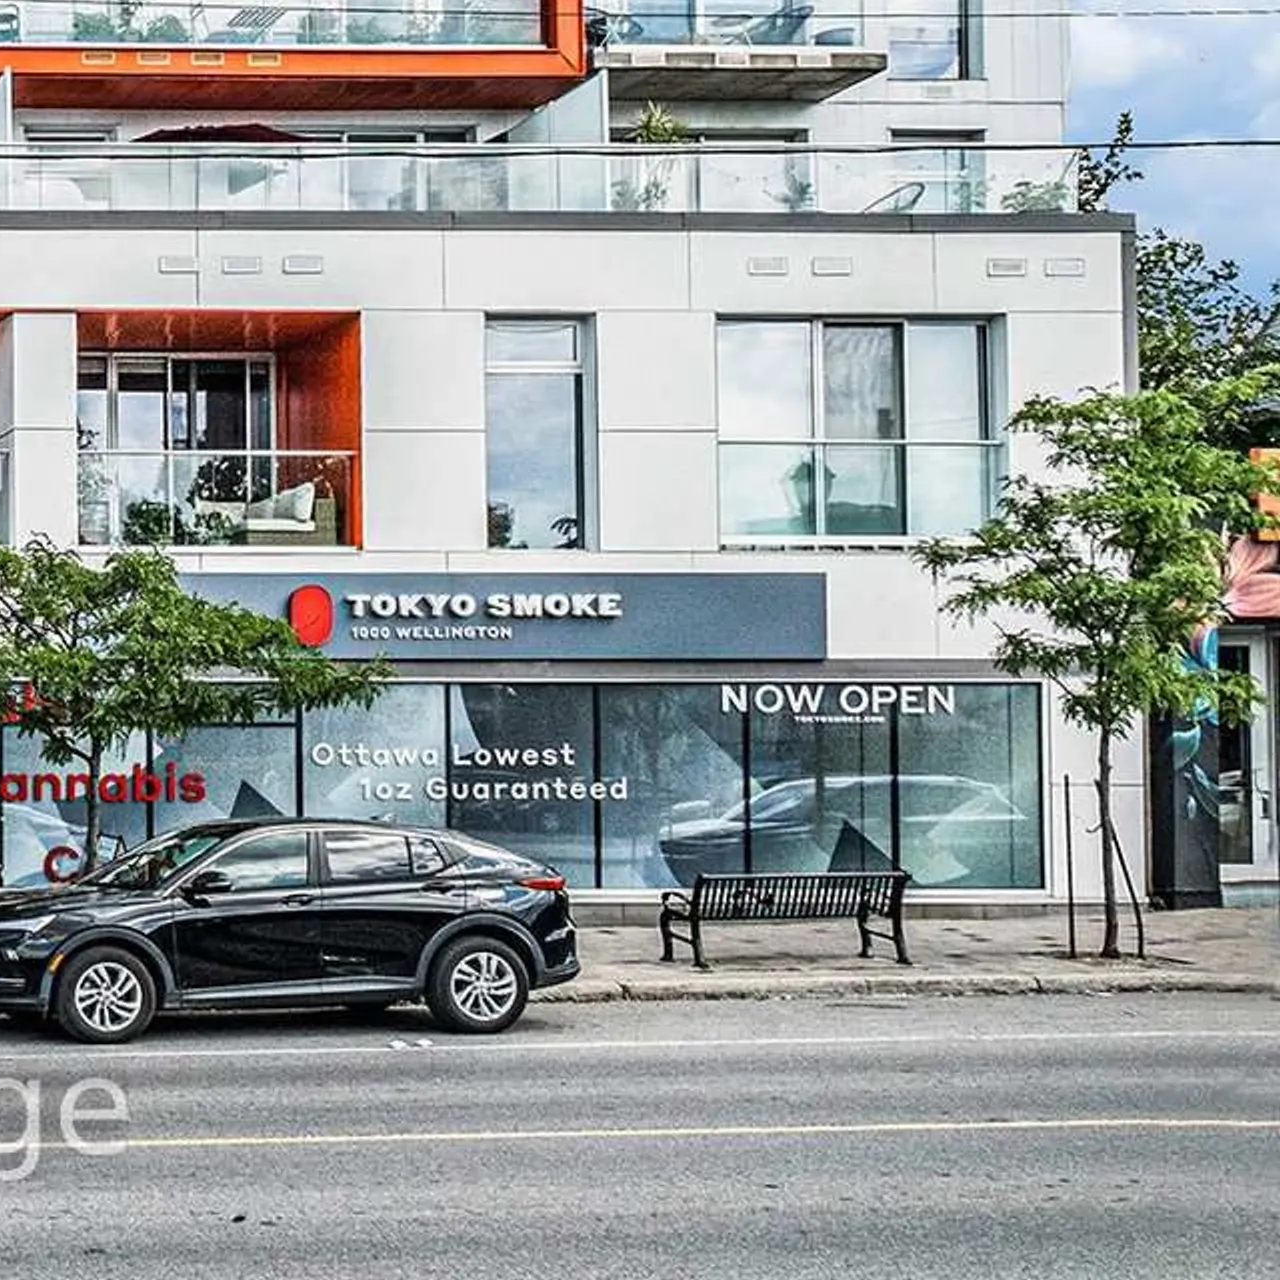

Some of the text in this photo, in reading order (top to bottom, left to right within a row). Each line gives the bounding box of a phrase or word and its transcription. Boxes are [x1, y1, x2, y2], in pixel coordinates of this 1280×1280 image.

[347, 592, 623, 618] TOKYO SMOKE
[395, 626, 513, 640] WELLINGTON
[721, 684, 956, 714] NOW OPEN
[312, 743, 576, 766] Ottawa Lowest
[360, 776, 628, 801] 1oz Guaranteed
